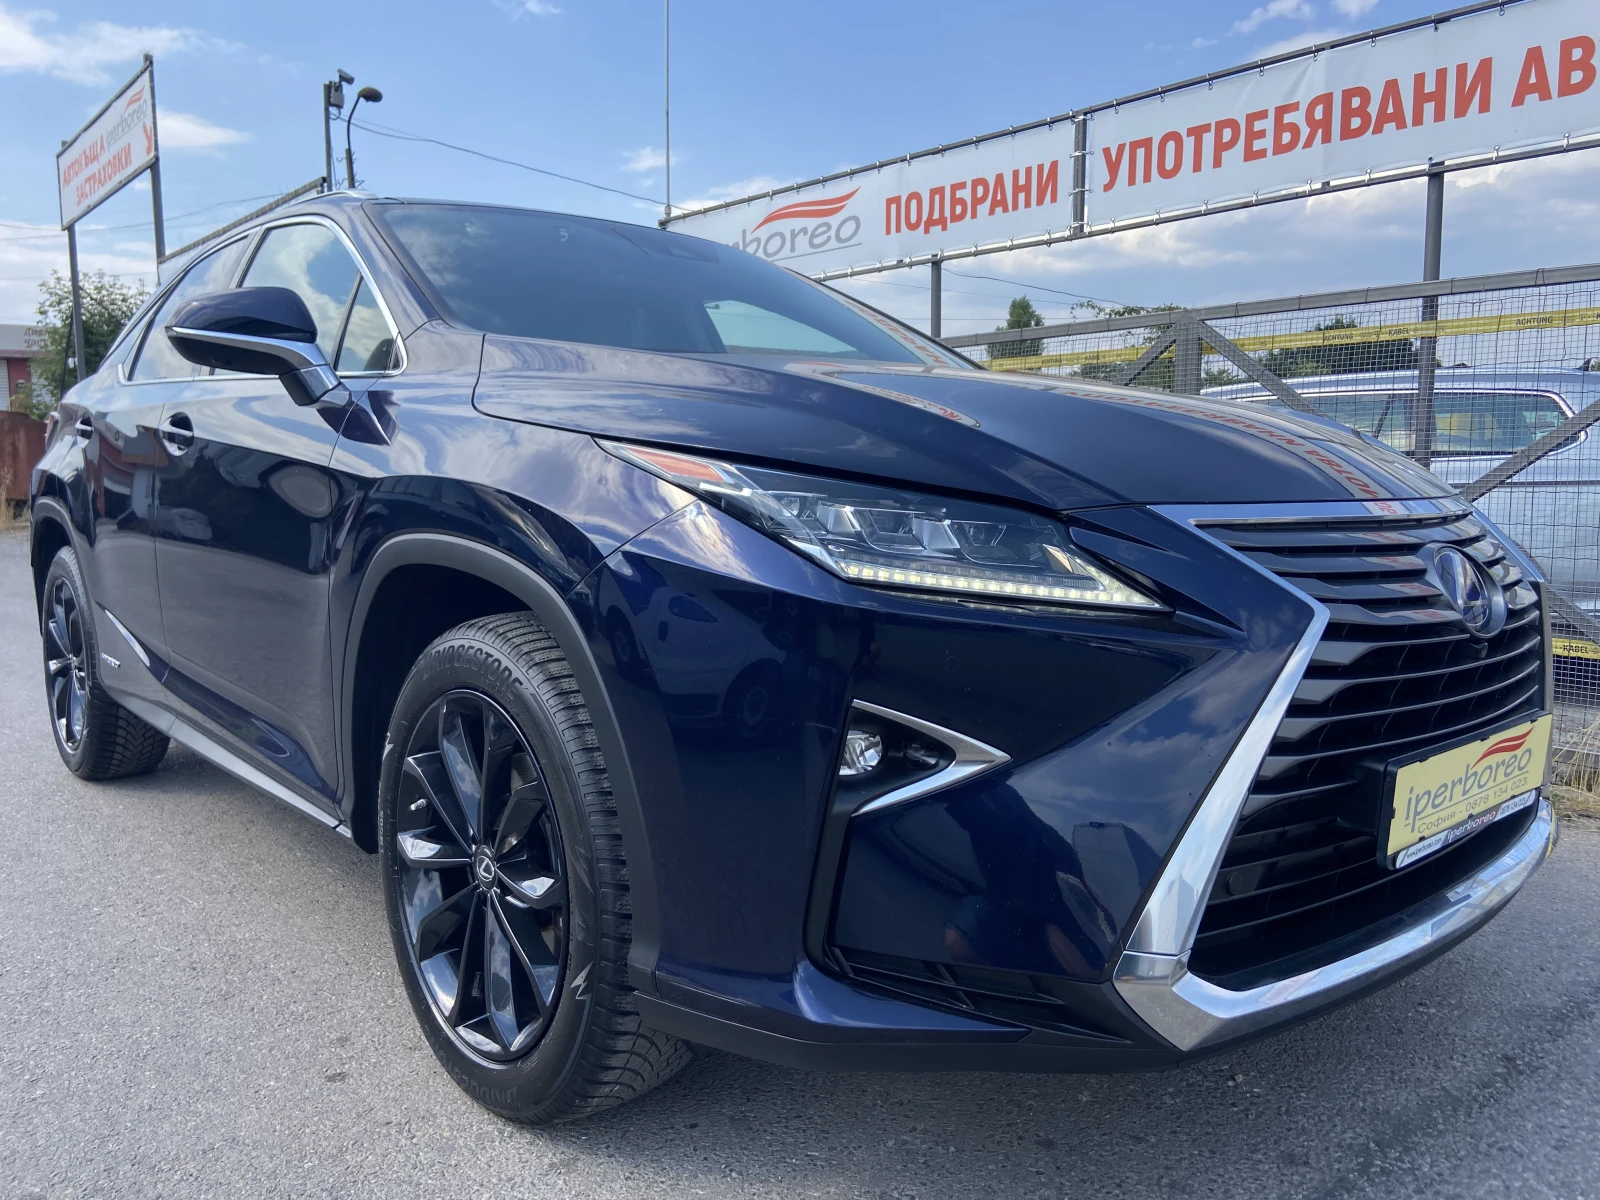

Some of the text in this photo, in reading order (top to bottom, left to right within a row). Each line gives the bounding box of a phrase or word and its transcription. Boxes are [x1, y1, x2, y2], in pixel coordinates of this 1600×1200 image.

[1102, 57, 1493, 193] УПОТРЕБЯВАНИ
[62, 134, 106, 189] АВТОКЪЩА
[76, 142, 132, 207] ЗАСТРАХОВКИ
[731, 160, 1059, 258] boreo ПОДБРАНИ
[1324, 332, 1354, 342] ACHTUNG
[1388, 327, 1410, 336] KABEL
[1516, 315, 1553, 326] ACHTUNG
[422, 643, 524, 700] BRIDGESTONE
[1563, 644, 1589, 654] KABEL
[1405, 747, 1532, 834] iperboreo
[1417, 811, 1456, 834] София
[1465, 794, 1490, 812] 0878
[1493, 785, 1508, 799] 134
[1510, 776, 1528, 792] 023
[1447, 811, 1496, 843] iperboreo
